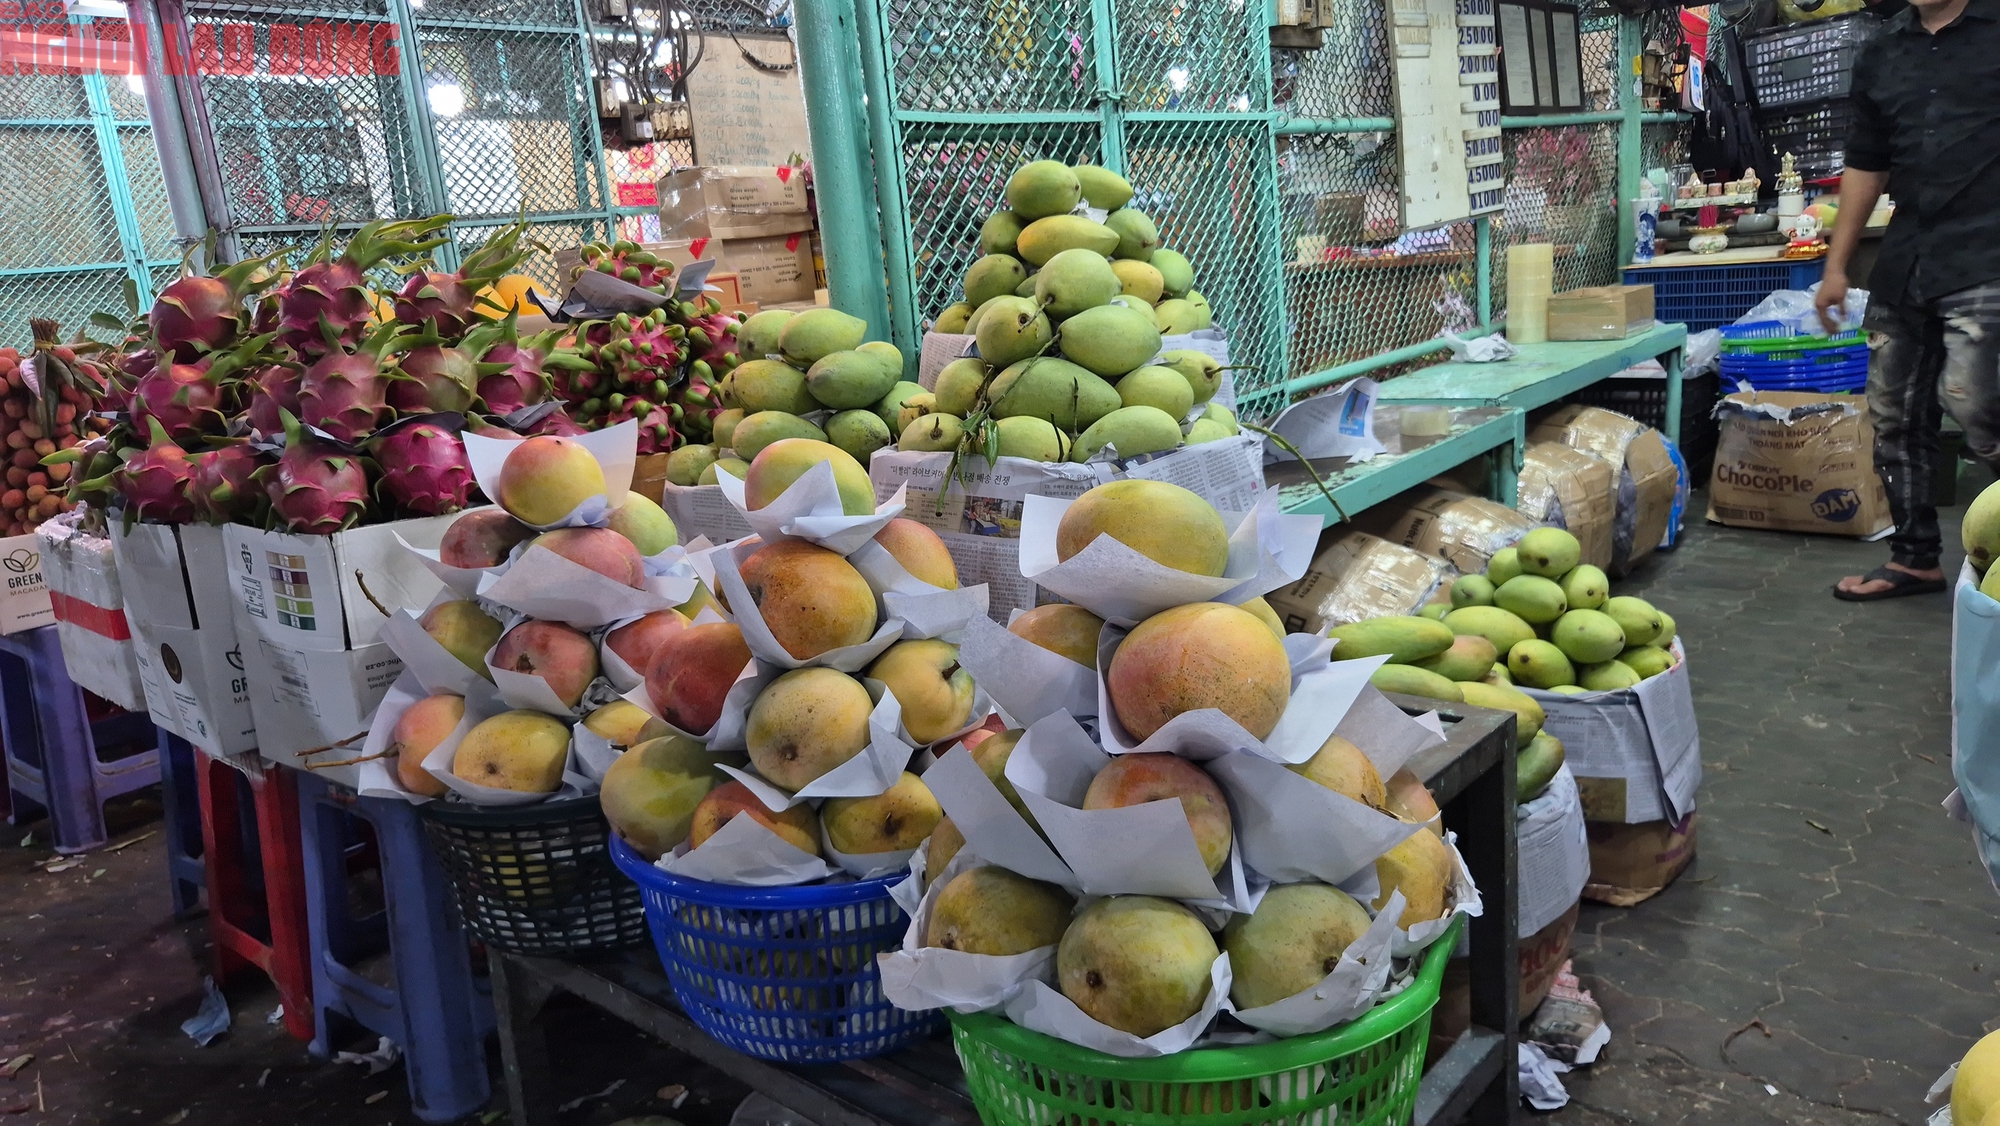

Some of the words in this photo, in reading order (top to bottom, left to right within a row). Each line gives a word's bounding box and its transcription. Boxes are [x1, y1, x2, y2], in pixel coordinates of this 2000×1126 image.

[1456, 0, 1491, 15] 55000
[1458, 26, 1494, 45] 25000
[1460, 55, 1495, 74] 20000
[1465, 136, 1500, 157] 50000
[1468, 163, 1501, 185] 45000
[1717, 463, 1814, 492] ChocoPie
[8, 572, 42, 588] GREEN
